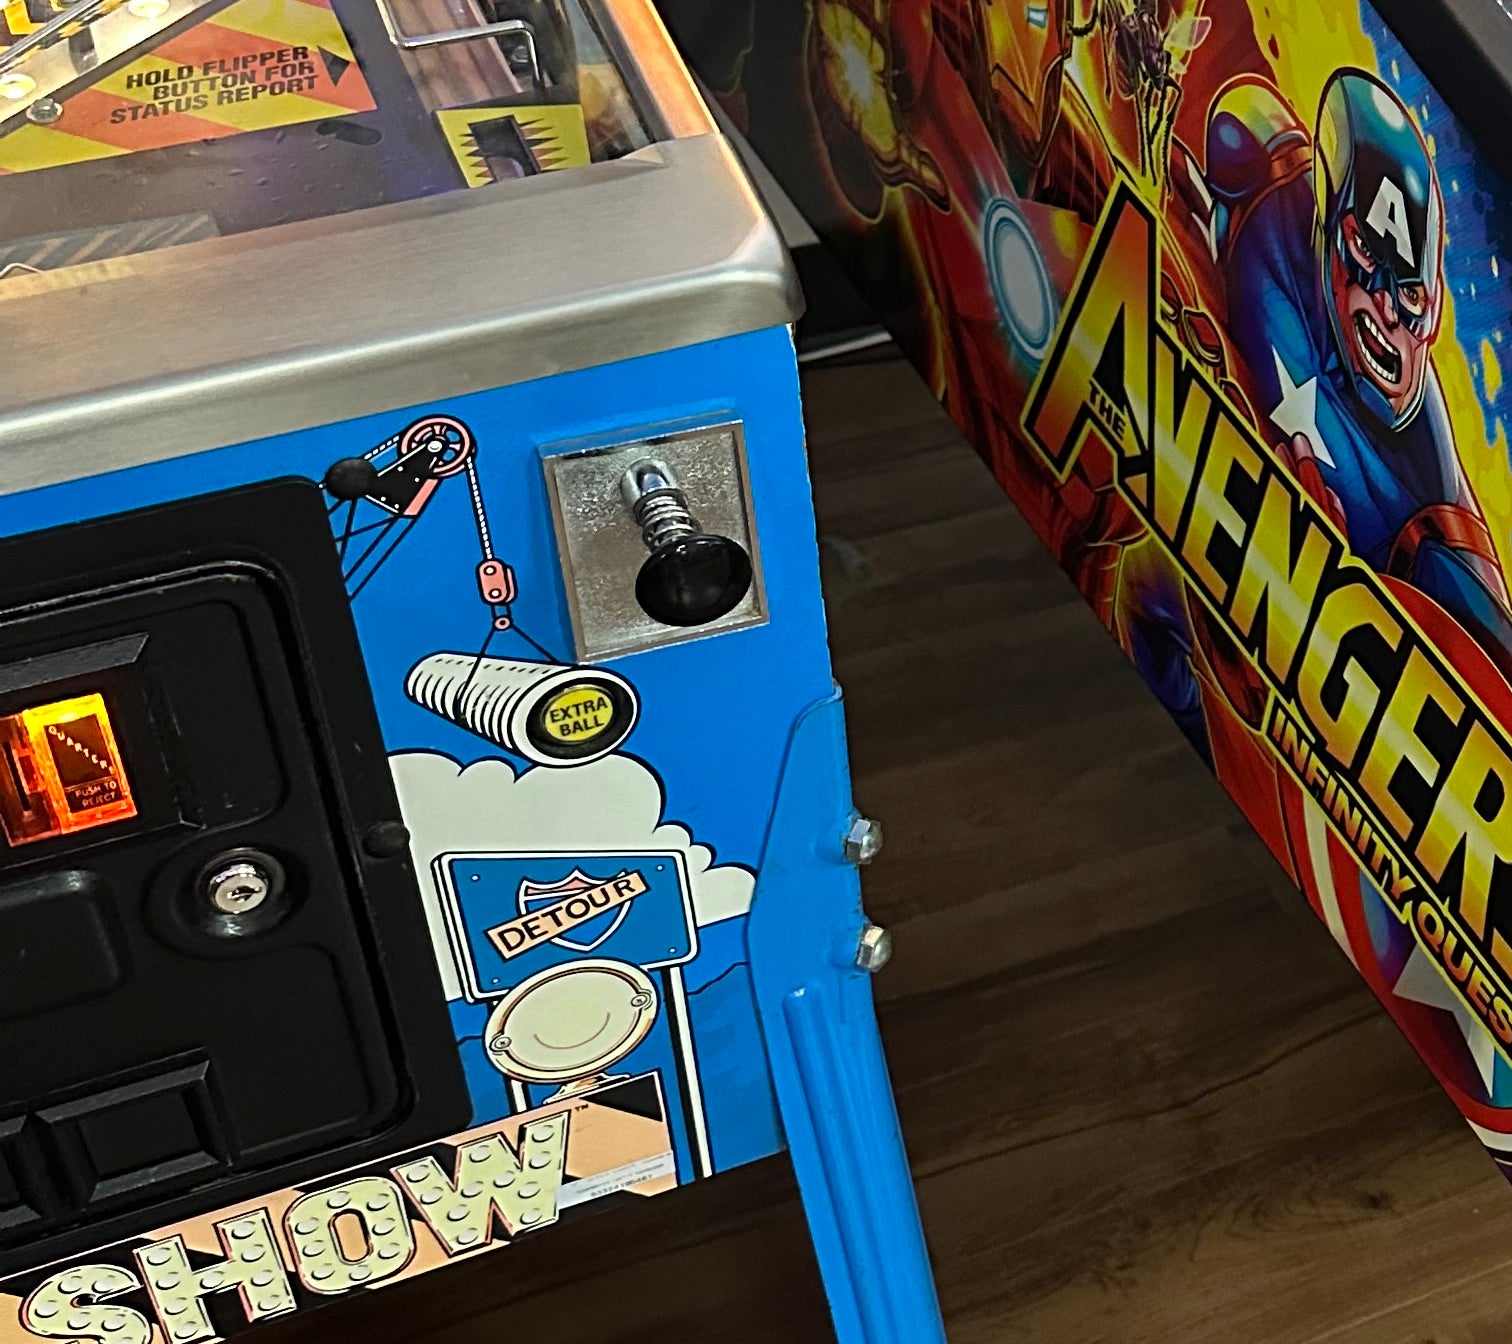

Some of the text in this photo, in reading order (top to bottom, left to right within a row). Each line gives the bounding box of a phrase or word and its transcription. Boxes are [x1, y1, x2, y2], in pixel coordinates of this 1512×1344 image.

[127, 46, 309, 90] HOLD FLIPPER
[154, 60, 316, 101] BUTTON FOR
[110, 75, 319, 124] STATUS REPORT
[1089, 379, 1126, 442] THE
[550, 696, 609, 723] EXTRA
[559, 714, 605, 737] BALL
[75, 781, 117, 798] PUSH TO
[82, 792, 117, 807] REJECT
[1268, 699, 1413, 912] INFINITY
[497, 878, 637, 952] DETOUR
